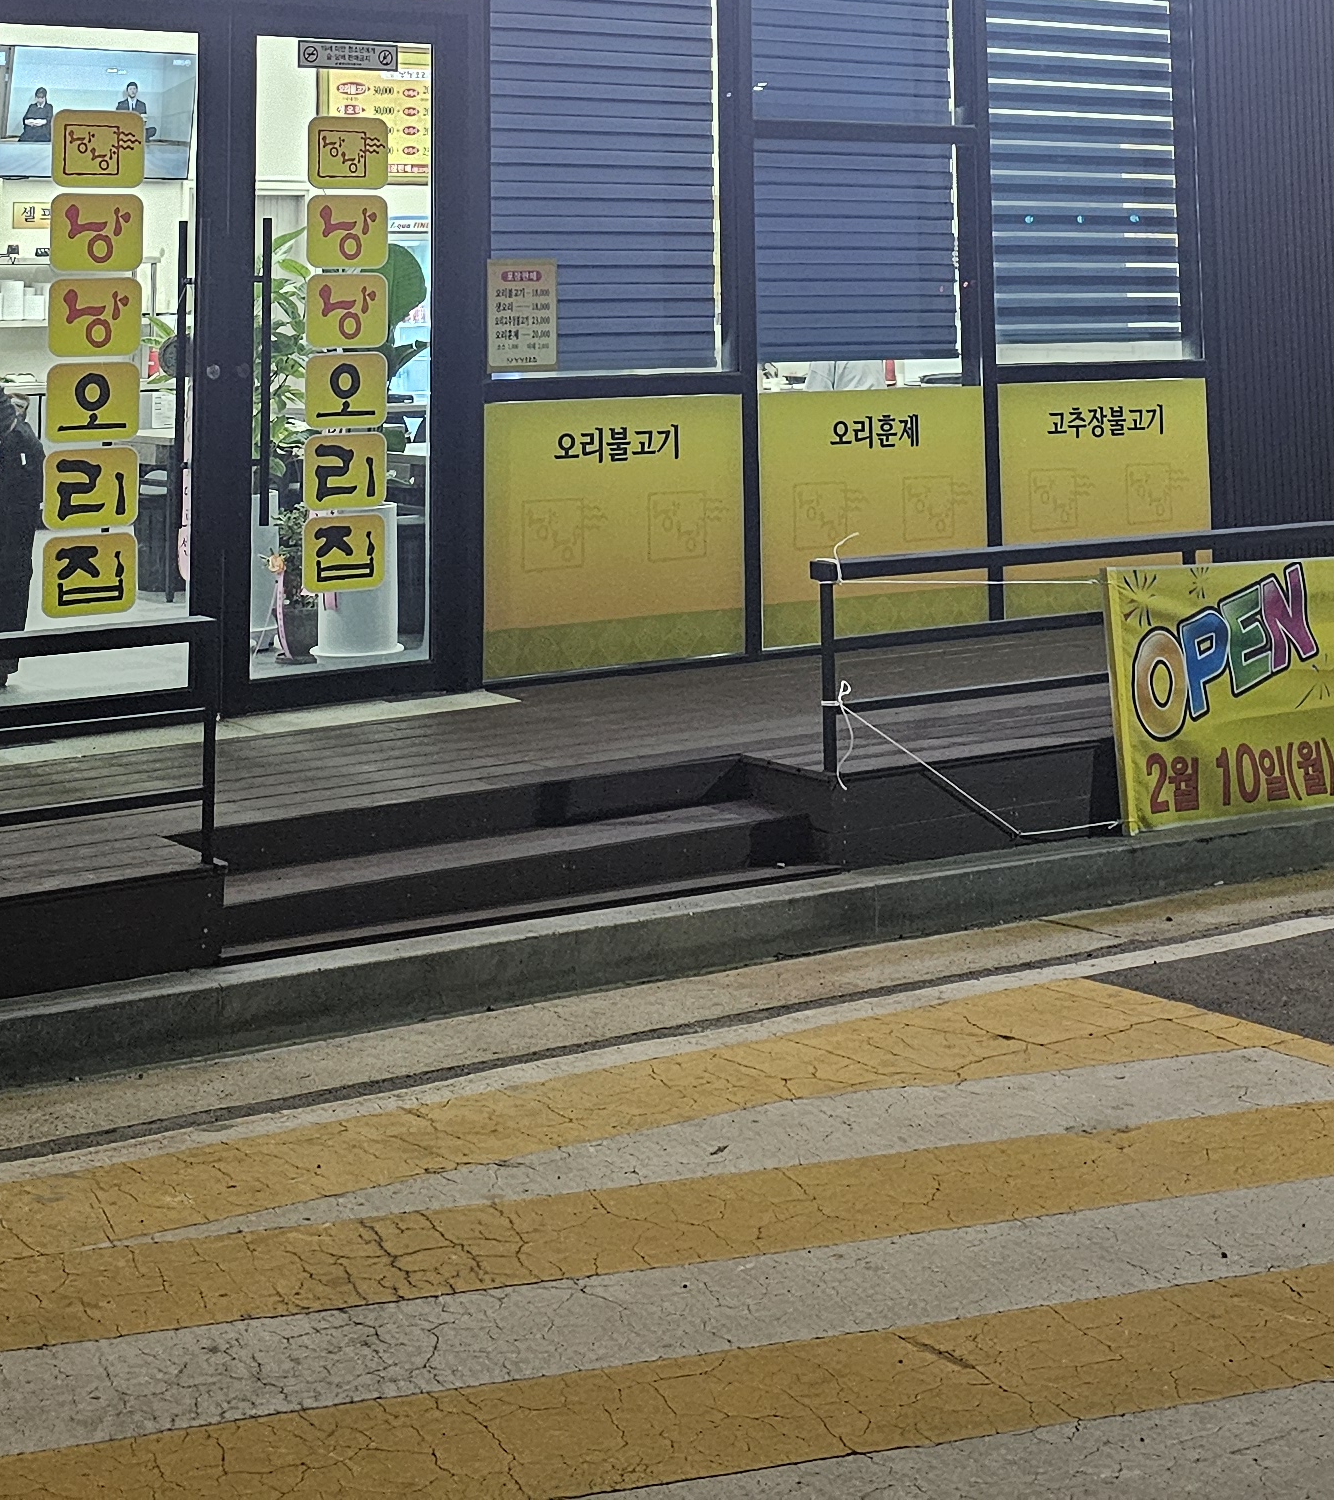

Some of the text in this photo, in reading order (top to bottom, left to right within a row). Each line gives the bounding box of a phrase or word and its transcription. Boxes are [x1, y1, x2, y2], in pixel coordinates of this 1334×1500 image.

[495, 288, 525, 298] 오리불고기
[830, 414, 921, 450] 오리훈제
[1047, 404, 1165, 439] 고추장불고기
[554, 424, 681, 464] 오리불고기
[1132, 562, 1319, 741] OPEN
[1146, 753, 1200, 814] 2월
